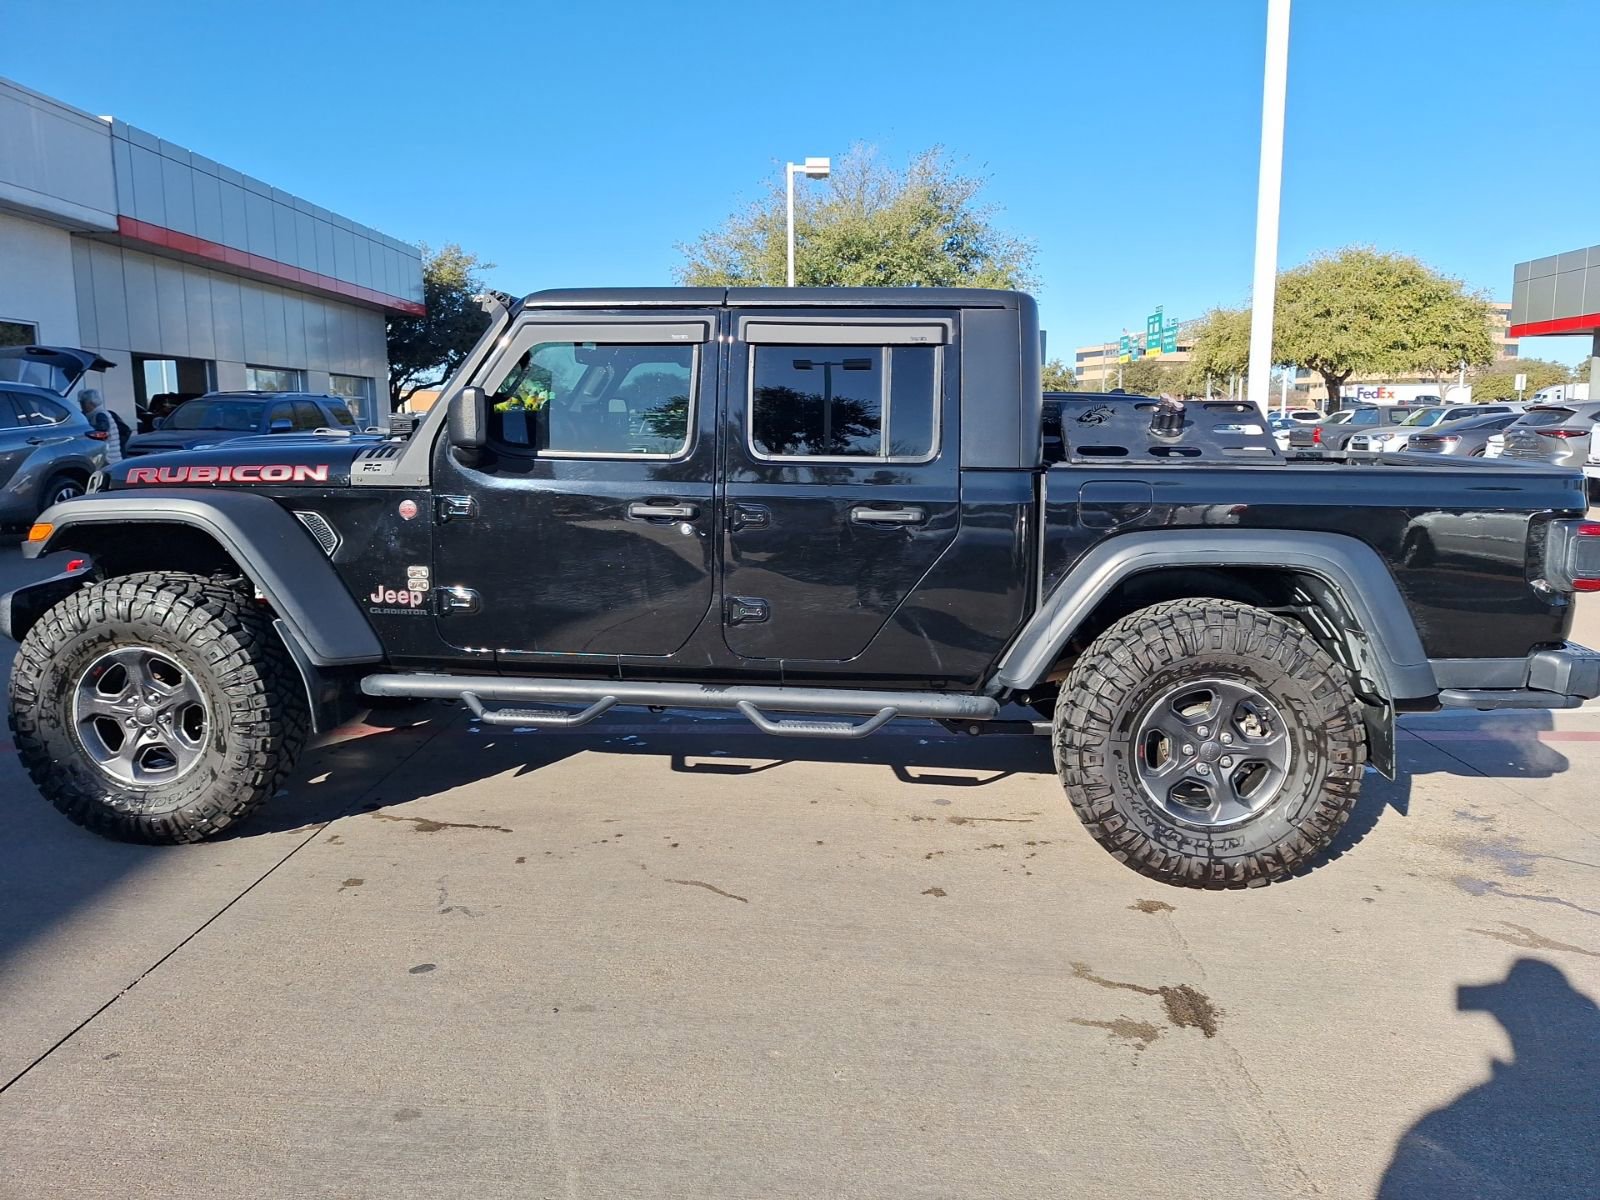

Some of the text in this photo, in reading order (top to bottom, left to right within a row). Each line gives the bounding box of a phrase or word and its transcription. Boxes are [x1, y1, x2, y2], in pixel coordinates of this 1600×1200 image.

[1357, 387, 1395, 399] FedEx
[126, 465, 329, 484] RUBICON
[370, 585, 423, 608] Jeep
[369, 607, 428, 616] GLADIATOR
